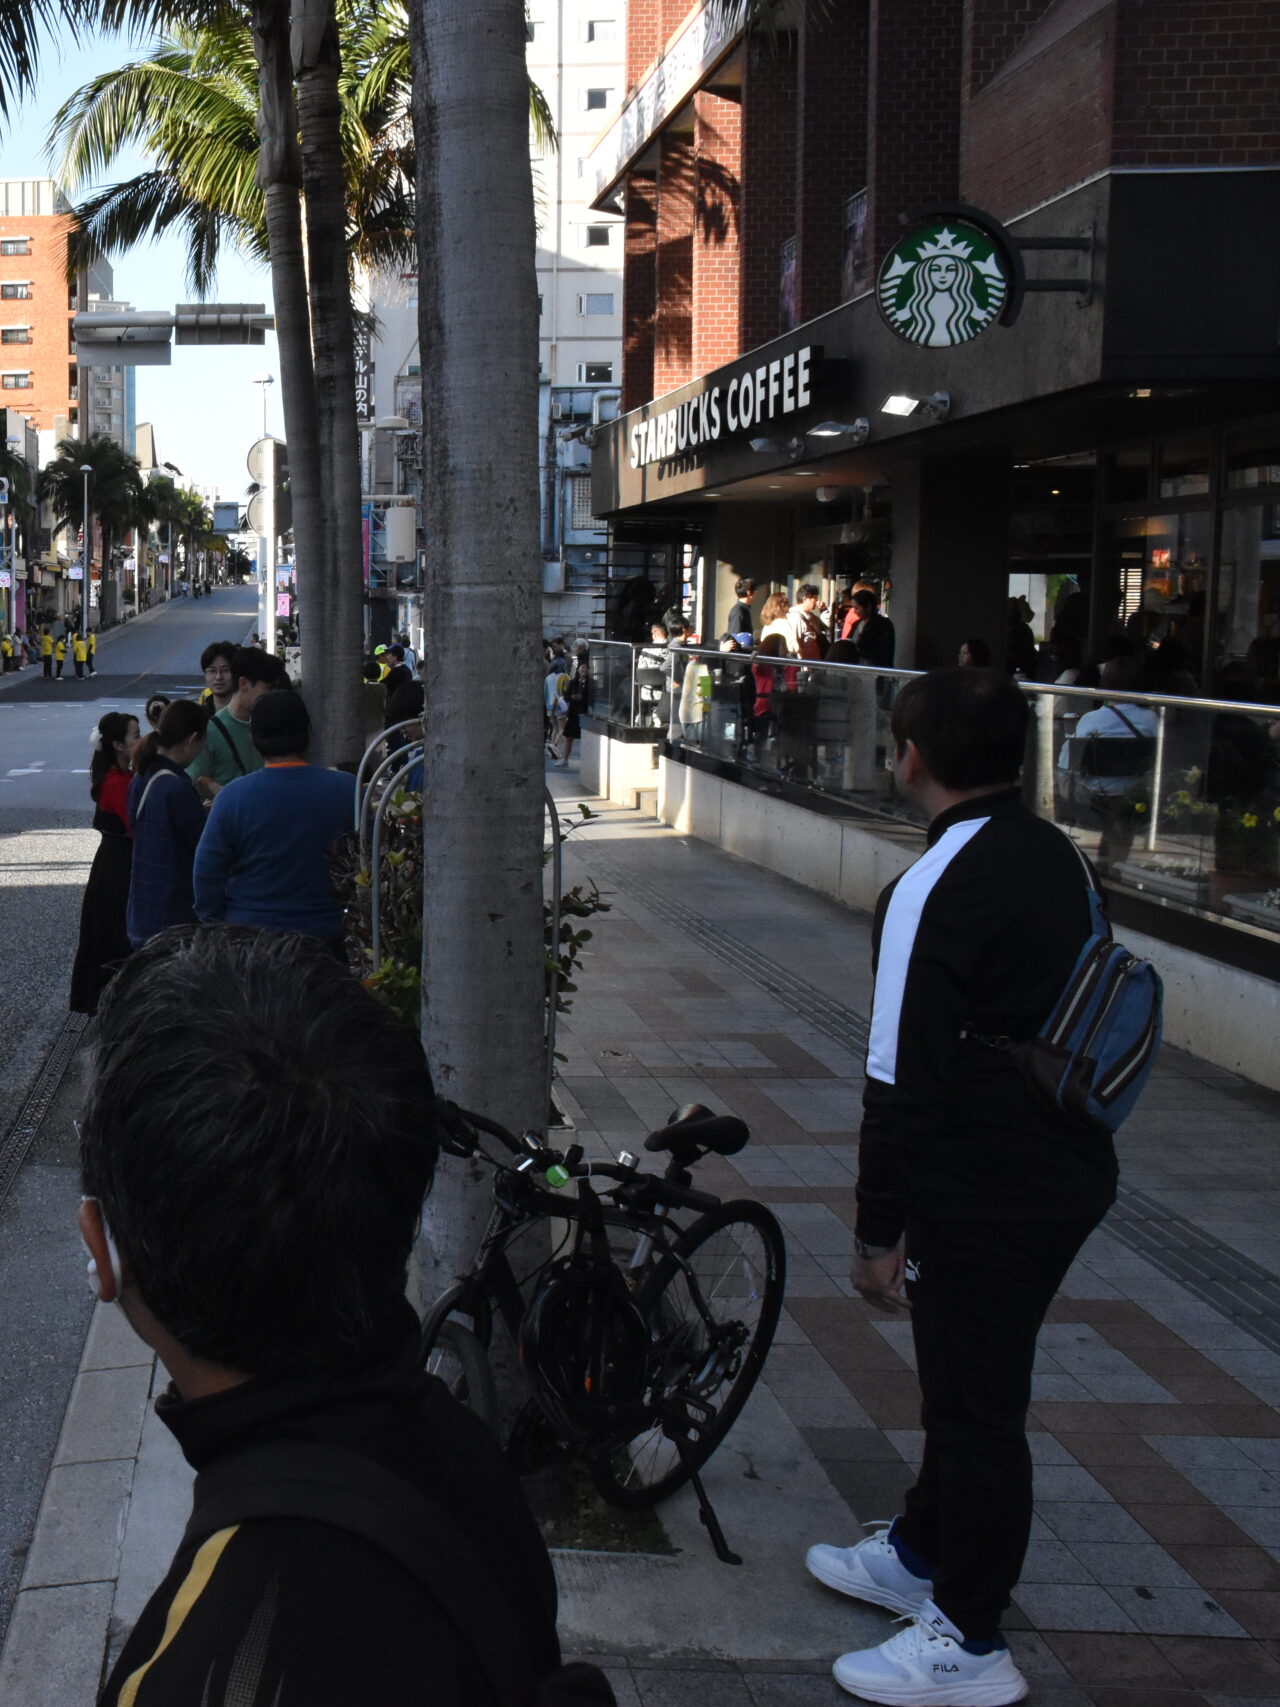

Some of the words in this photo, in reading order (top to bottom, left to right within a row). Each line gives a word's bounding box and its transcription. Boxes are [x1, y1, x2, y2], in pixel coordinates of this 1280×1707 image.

[631, 385, 721, 470] STARBUCKS
[726, 346, 812, 432] COFFEE
[933, 1664, 959, 1673] FILA
